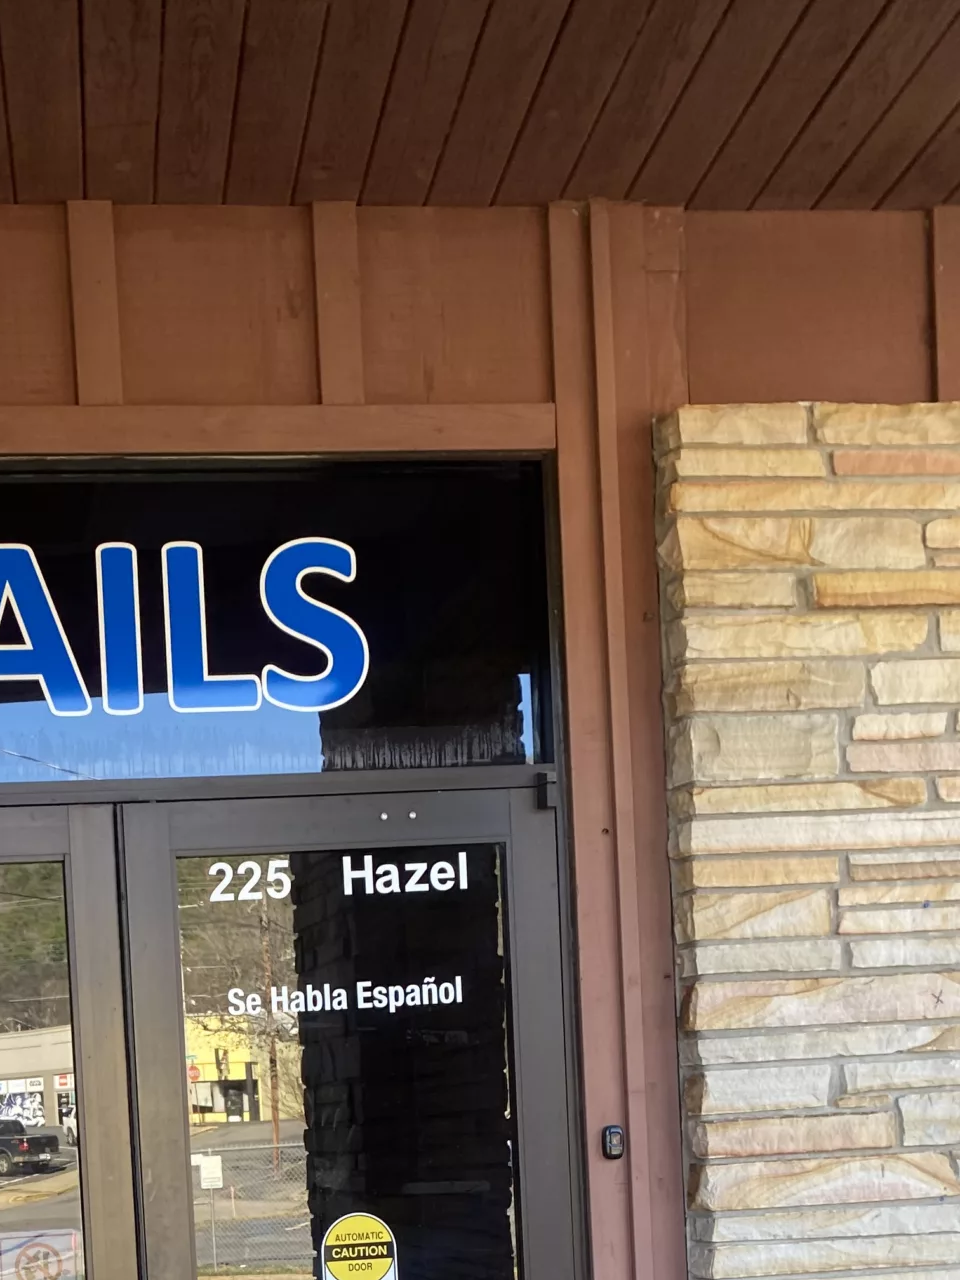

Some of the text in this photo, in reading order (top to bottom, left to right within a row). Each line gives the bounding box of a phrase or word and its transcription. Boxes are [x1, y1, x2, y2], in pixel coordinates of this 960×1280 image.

[207, 851, 469, 902] 225 Hazel
[227, 976, 463, 1016] Se Habla Español
[335, 1231, 384, 1242] AUTOMATIC
[332, 1245, 388, 1259] CAUTION
[348, 1263, 373, 1272] DOOR
